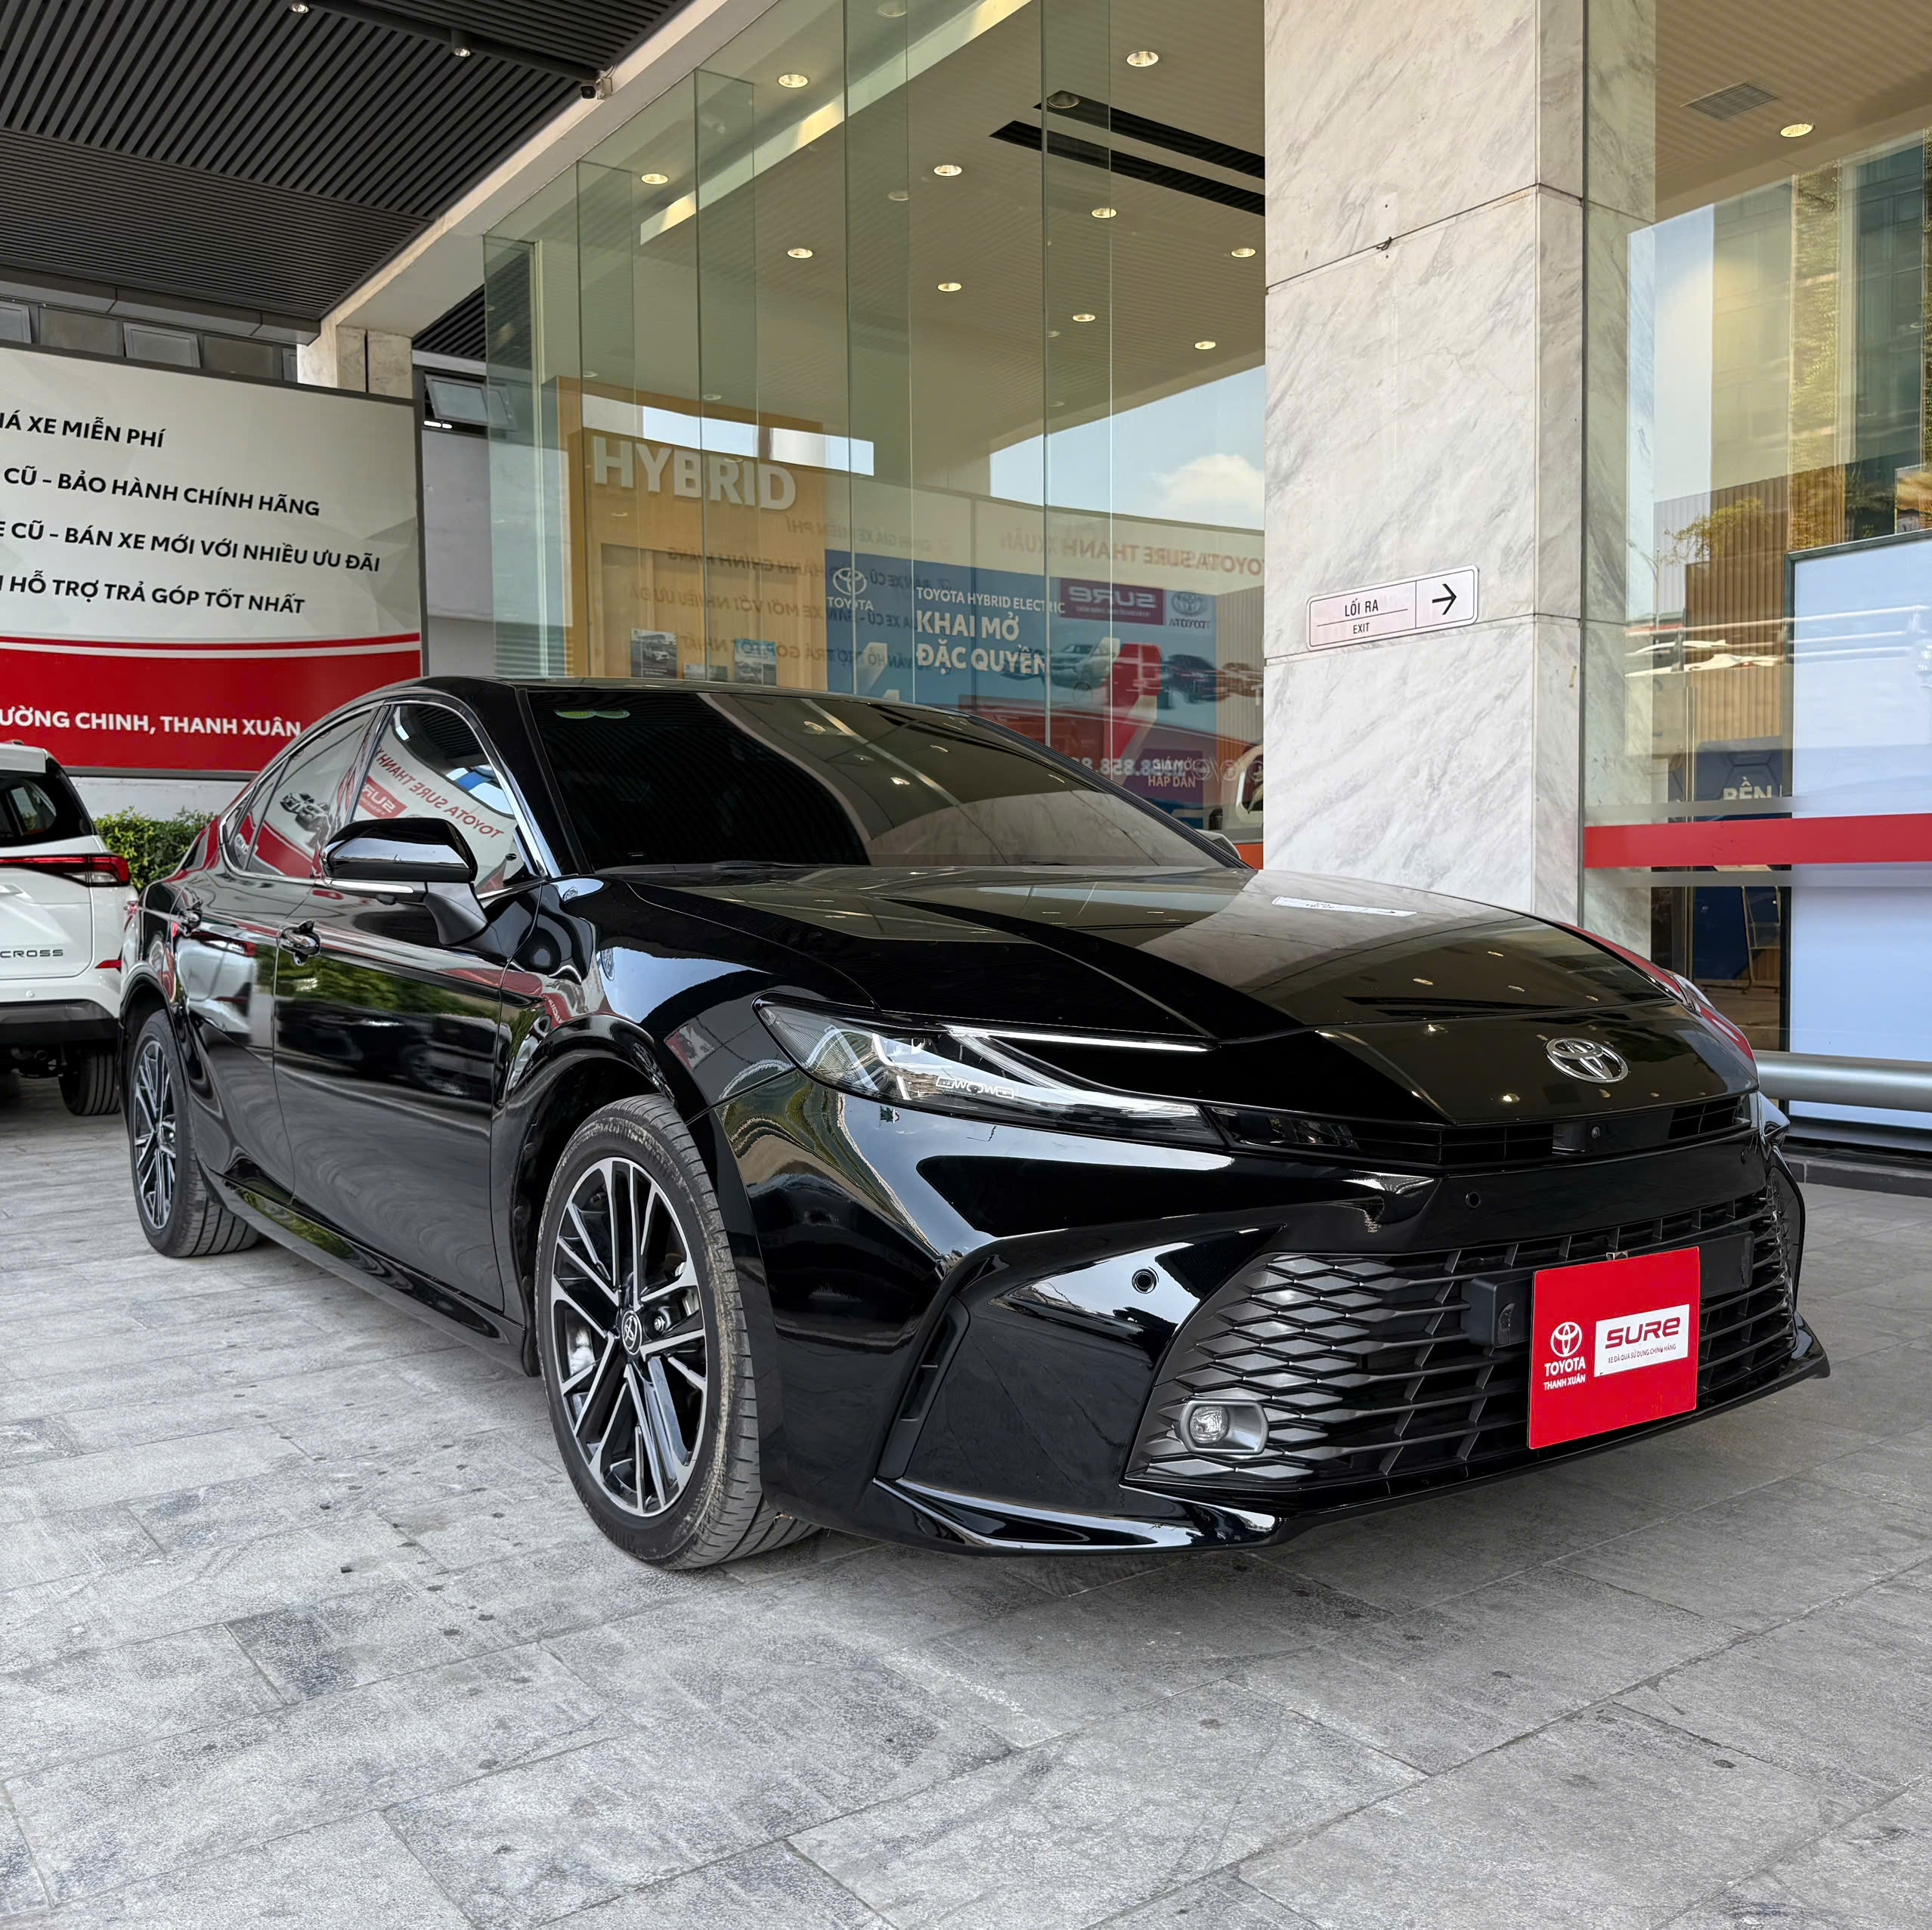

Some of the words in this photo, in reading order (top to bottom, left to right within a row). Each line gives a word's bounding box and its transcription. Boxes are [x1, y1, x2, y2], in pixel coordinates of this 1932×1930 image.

[27, 416, 57, 435] XE
[62, 416, 121, 443] MIỄN
[126, 428, 167, 447] PHÍ
[592, 435, 797, 511] HYBRID
[4, 465, 38, 486] CŨ
[57, 470, 107, 493] BẢO
[111, 477, 178, 502] HÀNH
[184, 487, 254, 509] CHÍNH
[259, 493, 320, 516] HÃNG
[11, 520, 45, 540] CŨ
[65, 524, 113, 547] BÁN
[117, 532, 146, 550] XE
[150, 534, 195, 555] MỚI
[200, 538, 238, 558] VỚI
[243, 543, 308, 564] NHIỀU
[313, 549, 341, 568] ƯU
[345, 552, 380, 572] ĐÃI
[10, 570, 46, 594] HỖ
[52, 579, 99, 603] TRỢ
[104, 580, 146, 602] TRẢ
[152, 585, 200, 605] GÓP
[204, 588, 244, 609] TỐT
[248, 592, 305, 614] NHẤT
[827, 596, 874, 611] TOYOTA
[916, 586, 966, 605] TOYOTA
[967, 592, 1011, 609] HYBRID
[1013, 598, 1066, 614] ELECTRIC
[1344, 598, 1361, 617] LỐI
[1364, 599, 1379, 614] RA
[916, 610, 975, 638] KHAI
[981, 611, 1020, 641] MỞ
[1353, 623, 1370, 634] EXIT
[915, 639, 967, 675] ĐẶC
[971, 644, 1047, 675] QUYỀN
[0, 705, 70, 728] ƯỜNG
[76, 712, 155, 735] CHINH,
[159, 716, 237, 735] THANH
[242, 716, 301, 738] XUÂN
[0, 949, 63, 958] CROSS
[1543, 1378, 1568, 1390] THANH
[1567, 1373, 1586, 1386] XUÂN
[1544, 1356, 1586, 1377] TOYOTA
